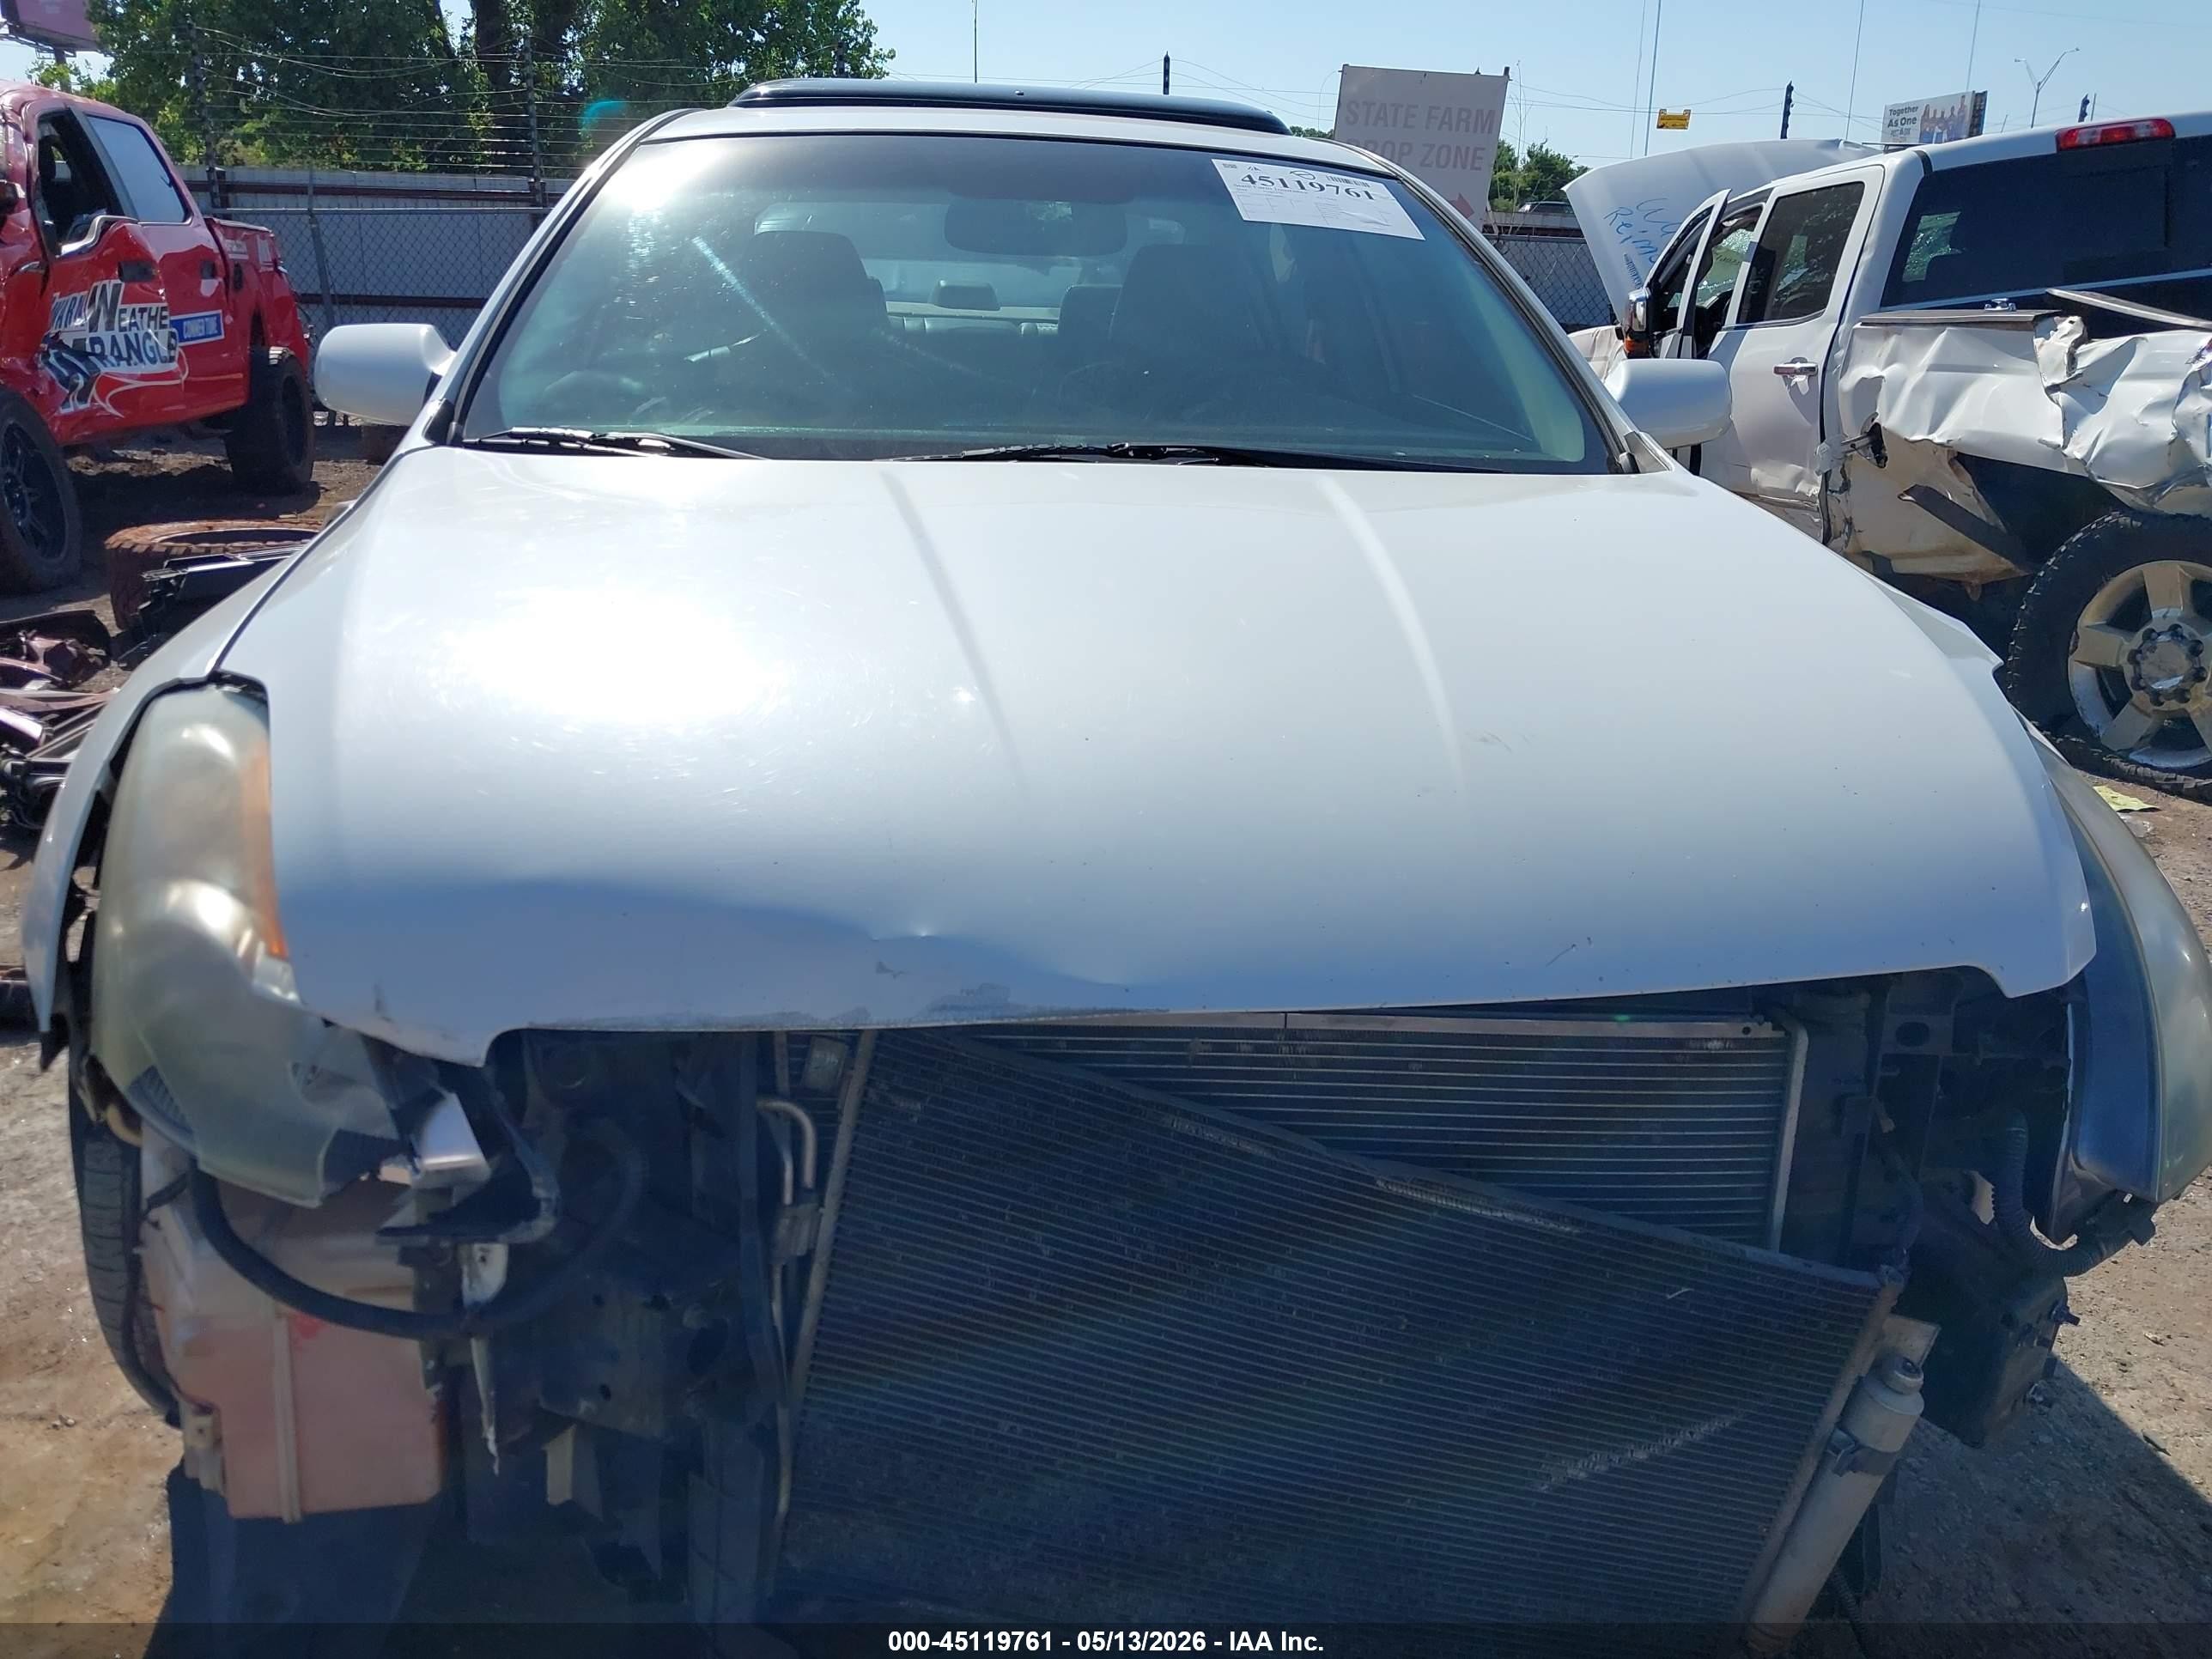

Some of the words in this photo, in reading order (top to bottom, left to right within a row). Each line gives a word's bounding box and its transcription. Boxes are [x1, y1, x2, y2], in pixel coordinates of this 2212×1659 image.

[1345, 100, 1419, 130] STATE
[1425, 106, 1496, 135] FARM
[1887, 118, 1899, 128] As
[1899, 116, 1917, 126] One
[1888, 106, 1918, 117] Together
[1346, 137, 1413, 166] OP
[1419, 143, 1486, 172] ZONE
[1241, 173, 1375, 200] 45119761
